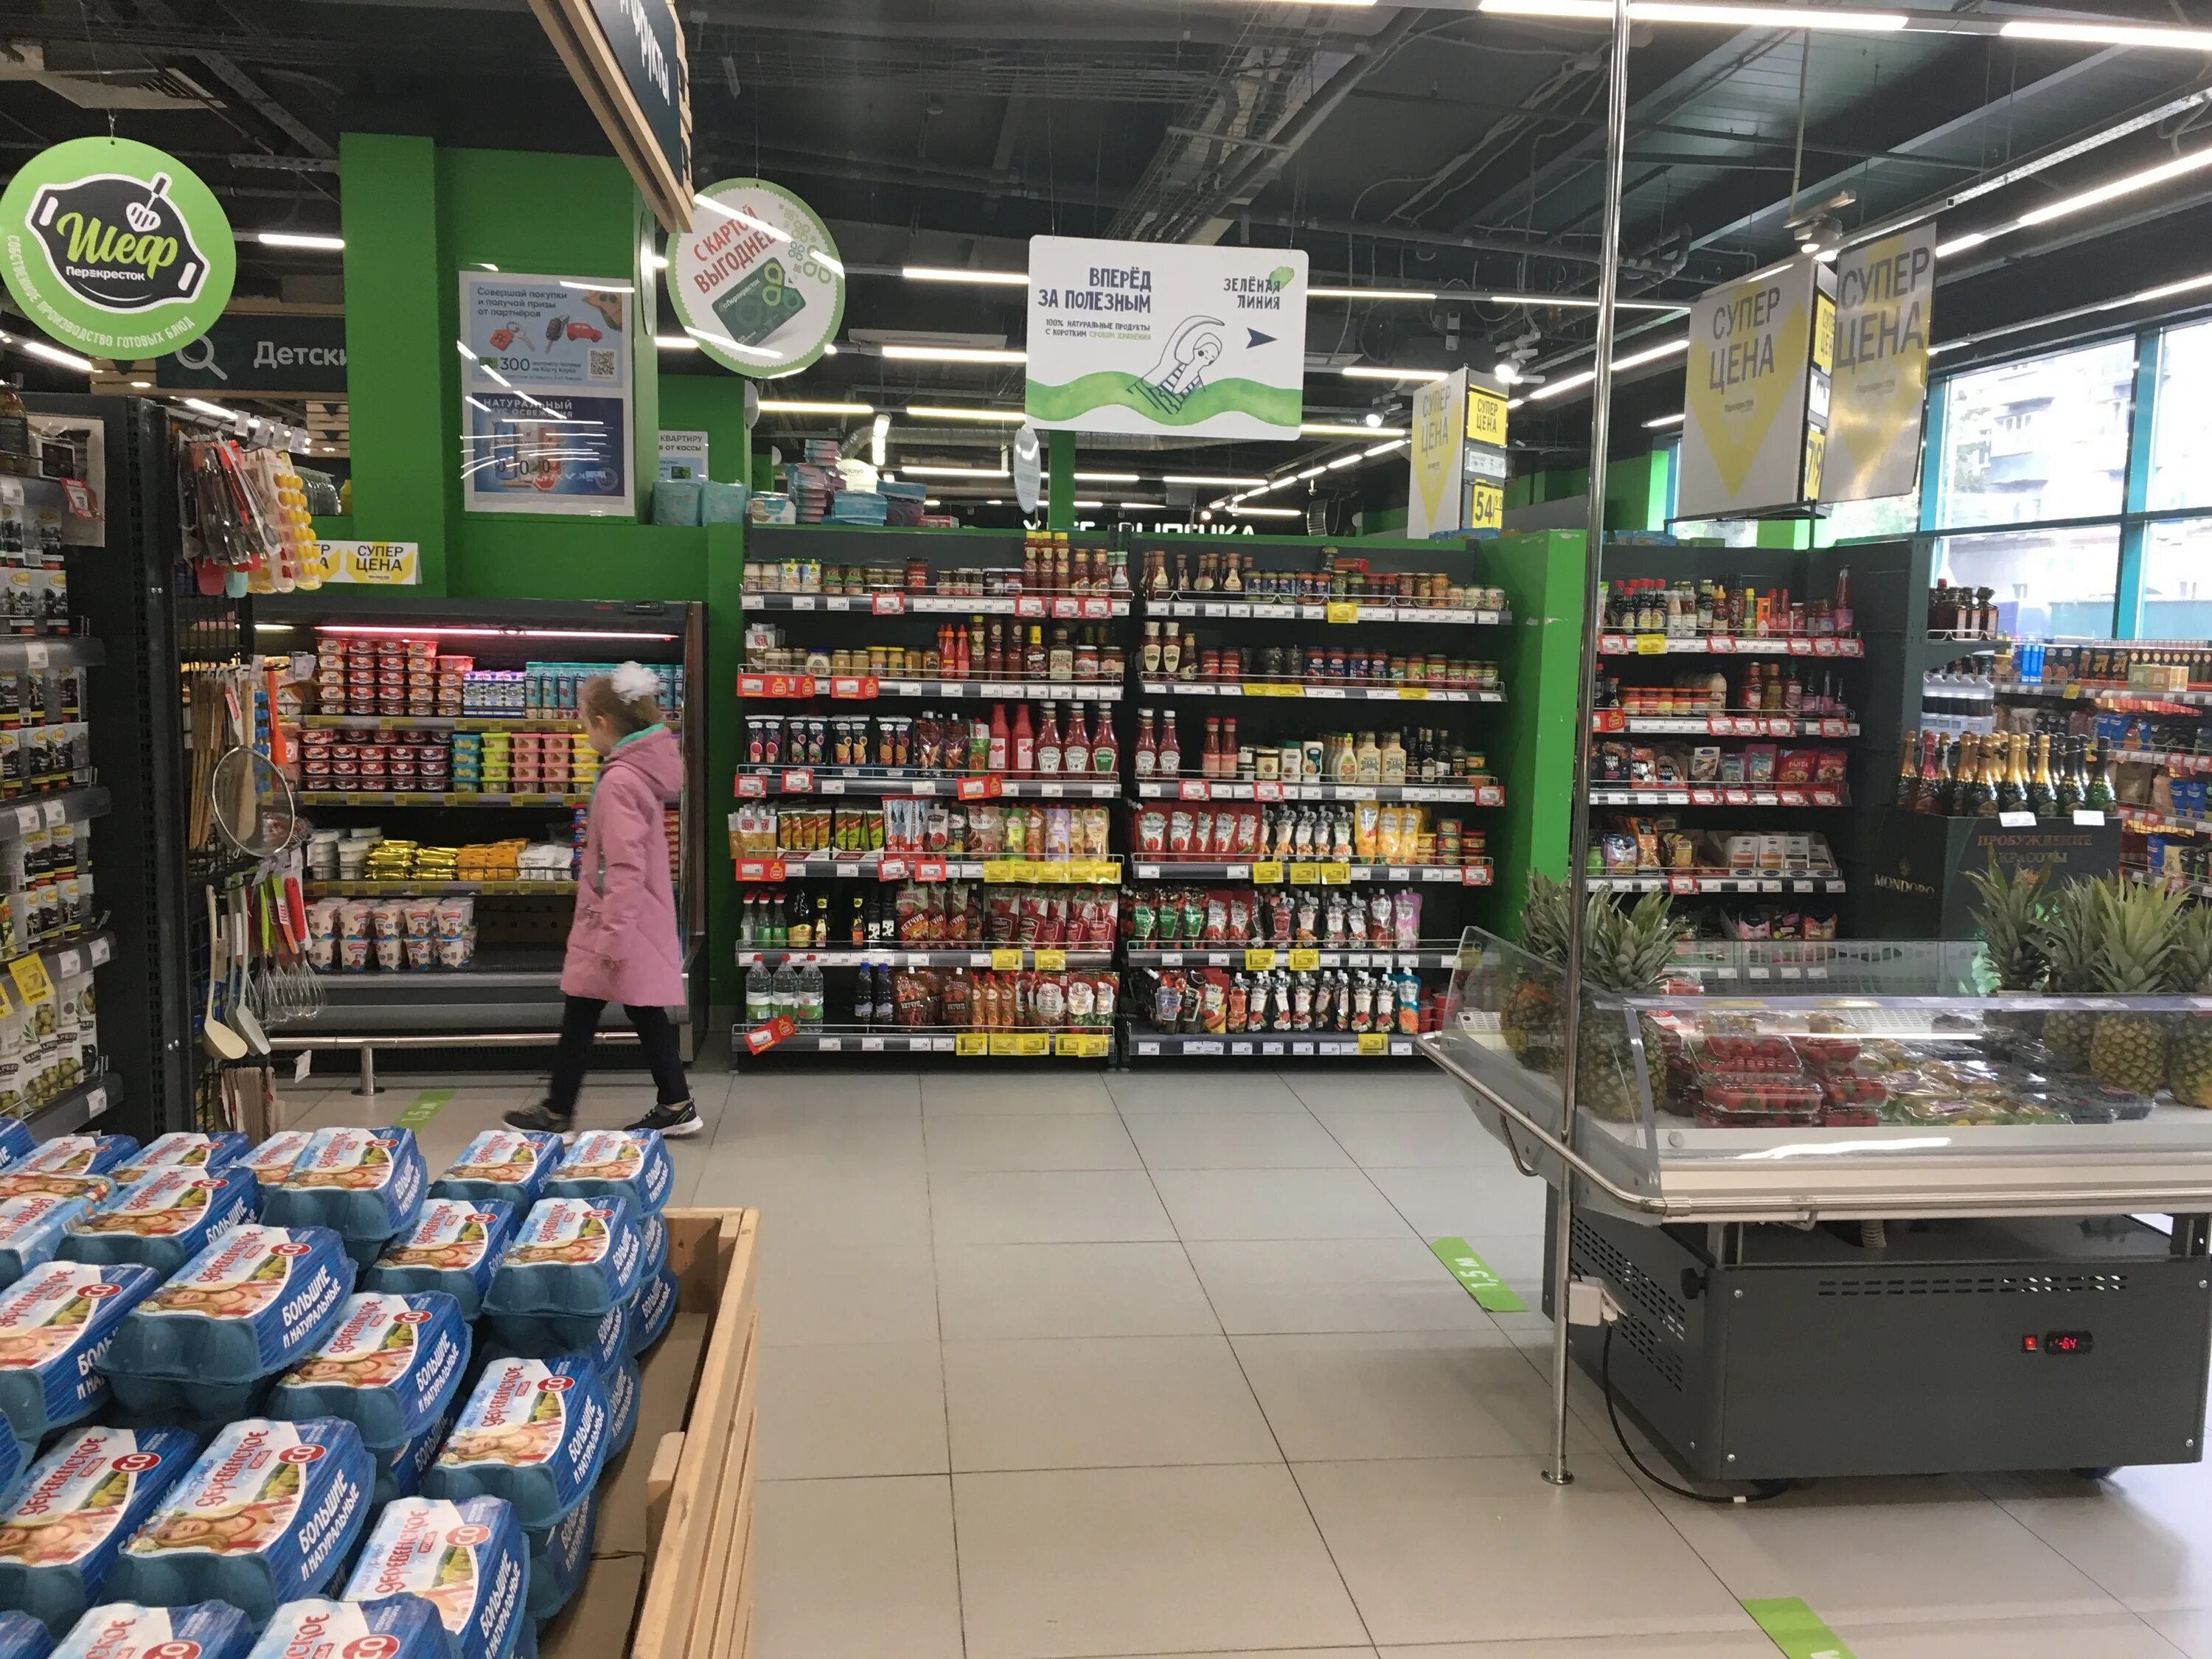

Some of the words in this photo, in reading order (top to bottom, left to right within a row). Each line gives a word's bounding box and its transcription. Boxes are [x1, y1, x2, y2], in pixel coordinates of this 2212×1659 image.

[56, 212, 178, 279] Шеф
[694, 244, 707, 261] С
[7, 234, 41, 303] СОБСТВЕННОЕ
[37, 301, 113, 347] ПРОИЗВОДСТВО
[117, 328, 164, 349] ГОТОВЫХ
[167, 316, 195, 340] БЛЮД
[1089, 266, 1152, 292] ВПЕРЁД
[1223, 276, 1280, 293] ЗЕЛЁНАЯ
[1843, 246, 1930, 311] СУПЕР
[477, 287, 527, 298] Совершай
[529, 291, 567, 300] покупки
[486, 299, 525, 309] получай
[527, 301, 556, 309] призы
[1037, 289, 1059, 308] ЗА
[1065, 290, 1151, 313] ПОЛЕЗНЫМ
[1237, 295, 1280, 310] ЛИНИЯ
[490, 308, 541, 319] партнёров
[1046, 319, 1064, 327] 100%
[1067, 320, 1113, 330] НАТУРАЛЬНЫЕ
[1116, 323, 1150, 332] ПРОДУКТЫ
[1713, 286, 1781, 341] СУПЕР
[1053, 329, 1087, 337] КОРОТКИМ
[1836, 300, 1924, 375] ЦЕНА
[500, 357, 530, 371] 300
[1709, 333, 1775, 395] ЦЕНА
[1422, 385, 1451, 418] СУПЕР
[1477, 398, 1498, 417] СУПЕР
[660, 434, 702, 442] КВАРТИРУ
[1421, 417, 1448, 457] ЦЕНА
[1476, 417, 1497, 434] ЦЕНА
[1475, 491, 1493, 524] 54
[355, 557, 403, 572] ЦЕНА
[357, 545, 404, 557] СУПЕР
[1976, 833, 2093, 846] ПРОБУЖДЕНИЕ
[1874, 873, 1935, 894] MONDORO
[900, 913, 925, 933] КЕТЧУП
[282, 1264, 330, 1327] БОЛЬШИЕ
[291, 1278, 341, 1345] НАТУРАЛЬНЫЕ
[415, 1330, 451, 1393] БОЛЬШИЕ
[422, 1341, 461, 1409] НАТУРАЛЬНЫЕ
[568, 1394, 596, 1464] БОЛЬШИЕ
[578, 1405, 605, 1479] НАТУРАЛЬНЫЕ
[298, 1469, 348, 1554] БОЛЬШИЕ
[308, 1481, 360, 1574] НАТУРАЛЬНЫЕ
[480, 1548, 512, 1638] БОЛЬШИЕ
[490, 1559, 521, 1656] НАТУРАЛЬНЫЕ
